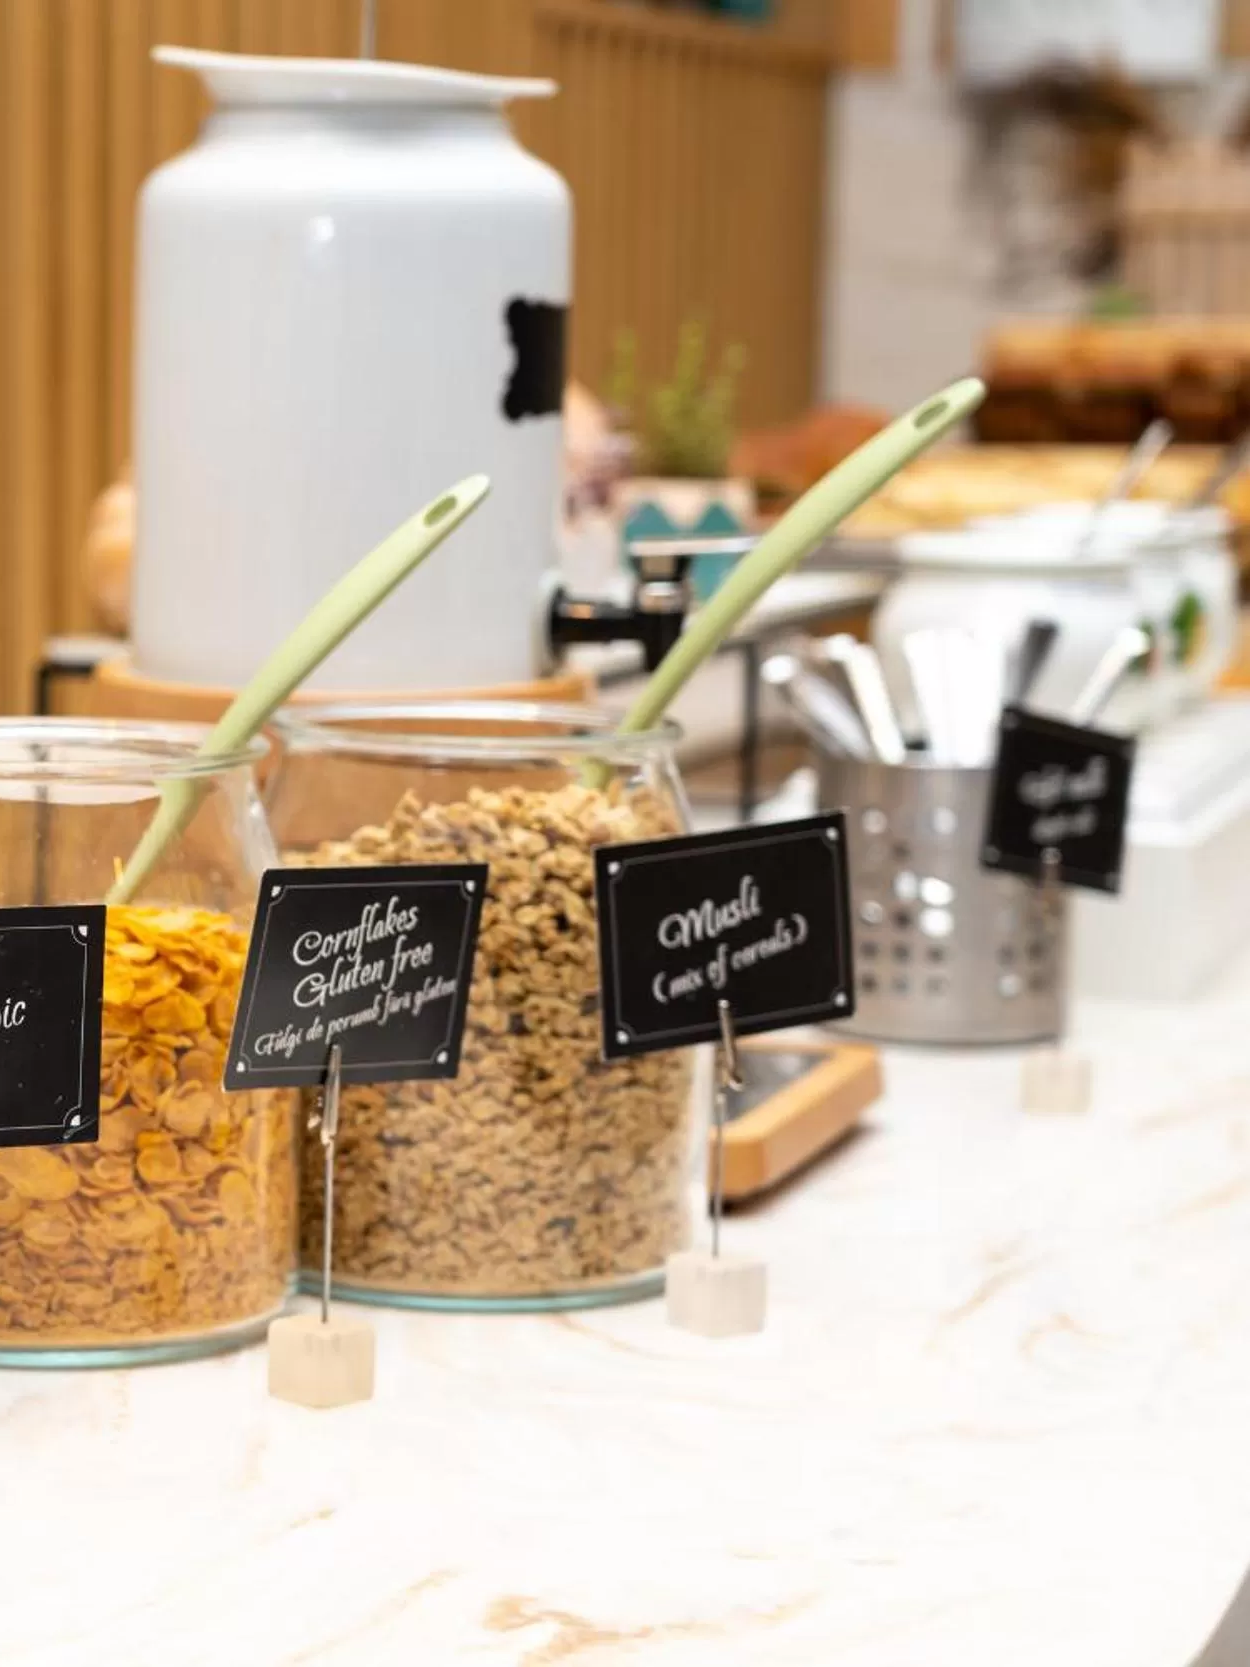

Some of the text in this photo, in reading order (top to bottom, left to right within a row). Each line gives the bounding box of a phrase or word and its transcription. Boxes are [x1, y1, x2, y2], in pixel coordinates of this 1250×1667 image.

[293, 896, 419, 966] Cornflakes
[658, 874, 762, 949] Musli
[293, 935, 434, 1007] Gluten free
[706, 943, 729, 990] of
[305, 1016, 325, 1042] de
